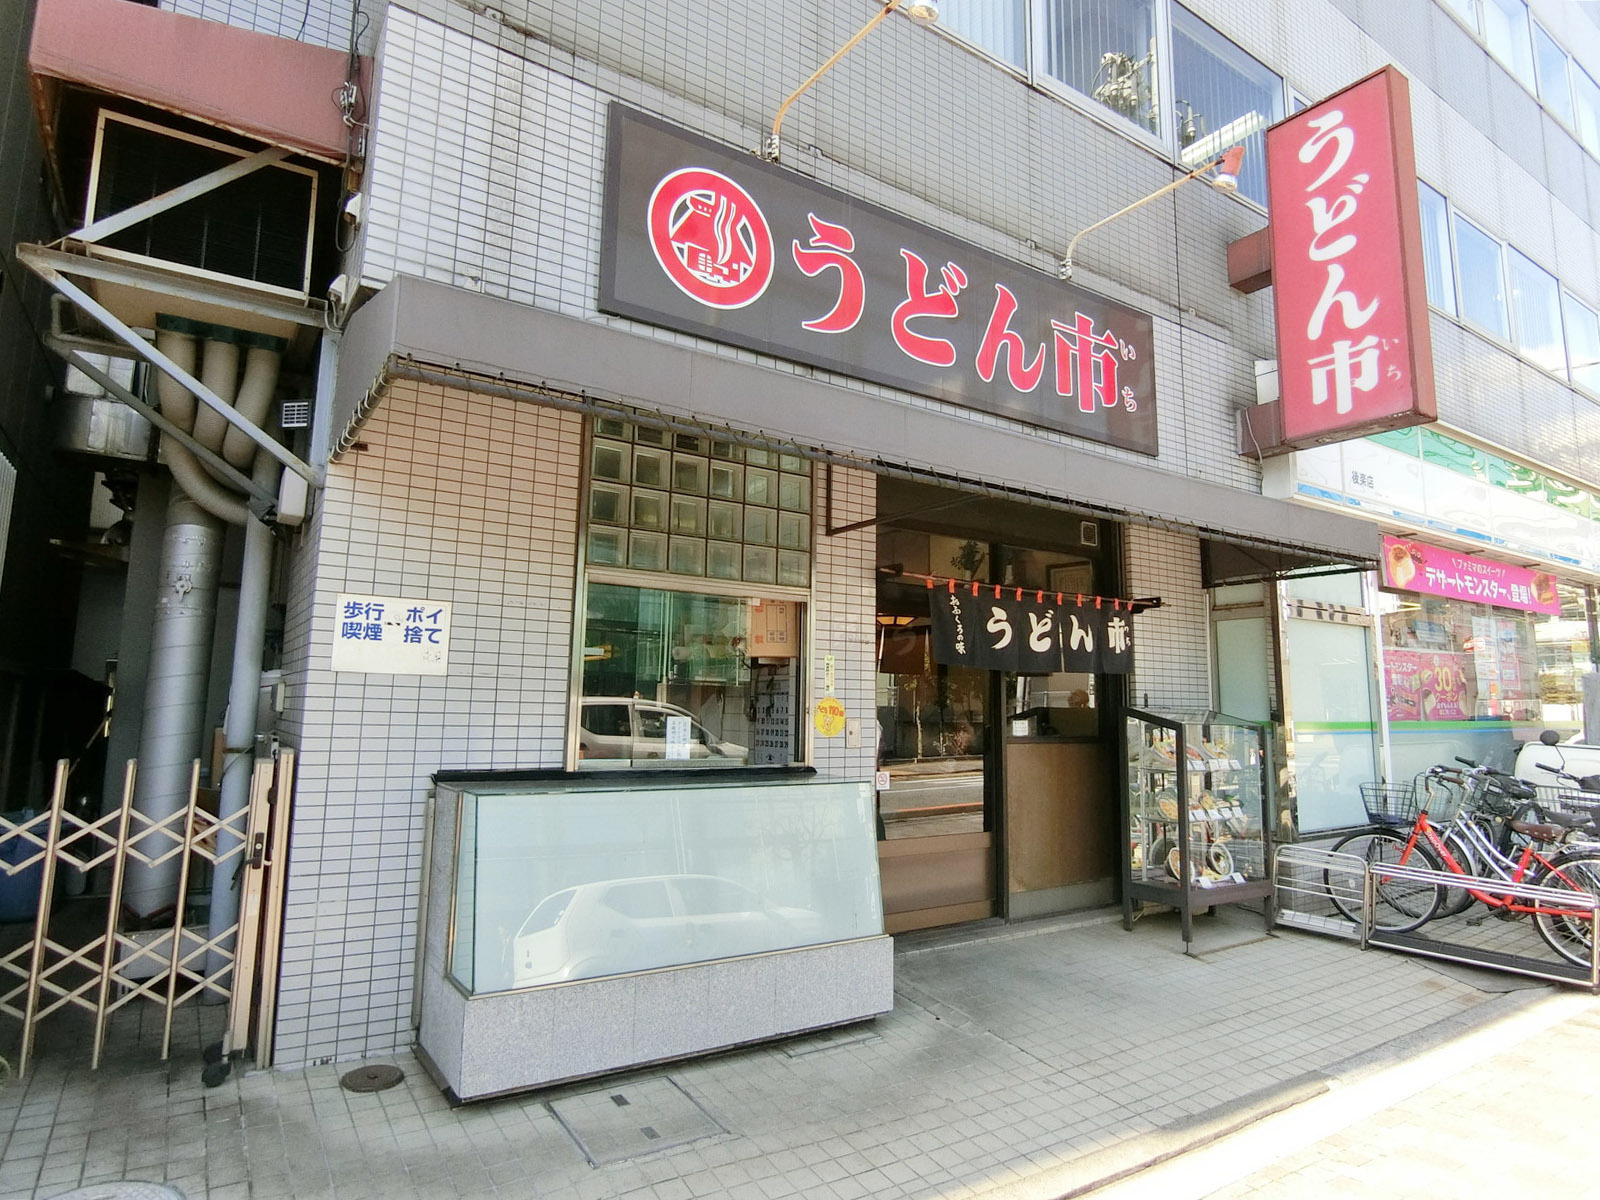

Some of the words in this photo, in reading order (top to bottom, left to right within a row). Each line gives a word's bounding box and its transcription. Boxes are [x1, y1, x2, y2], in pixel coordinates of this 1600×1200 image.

[1298, 110, 1380, 415] うどん市
[791, 212, 1119, 413] うどん市
[1119, 338, 1137, 412] いち
[1382, 337, 1402, 381] いち
[341, 622, 383, 641] 喫煙
[403, 625, 442, 644] 捨て
[343, 601, 385, 622] 歩行
[406, 607, 443, 625] ポイ
[986, 606, 1125, 654] うどん市
[1434, 667, 1452, 692] 30
